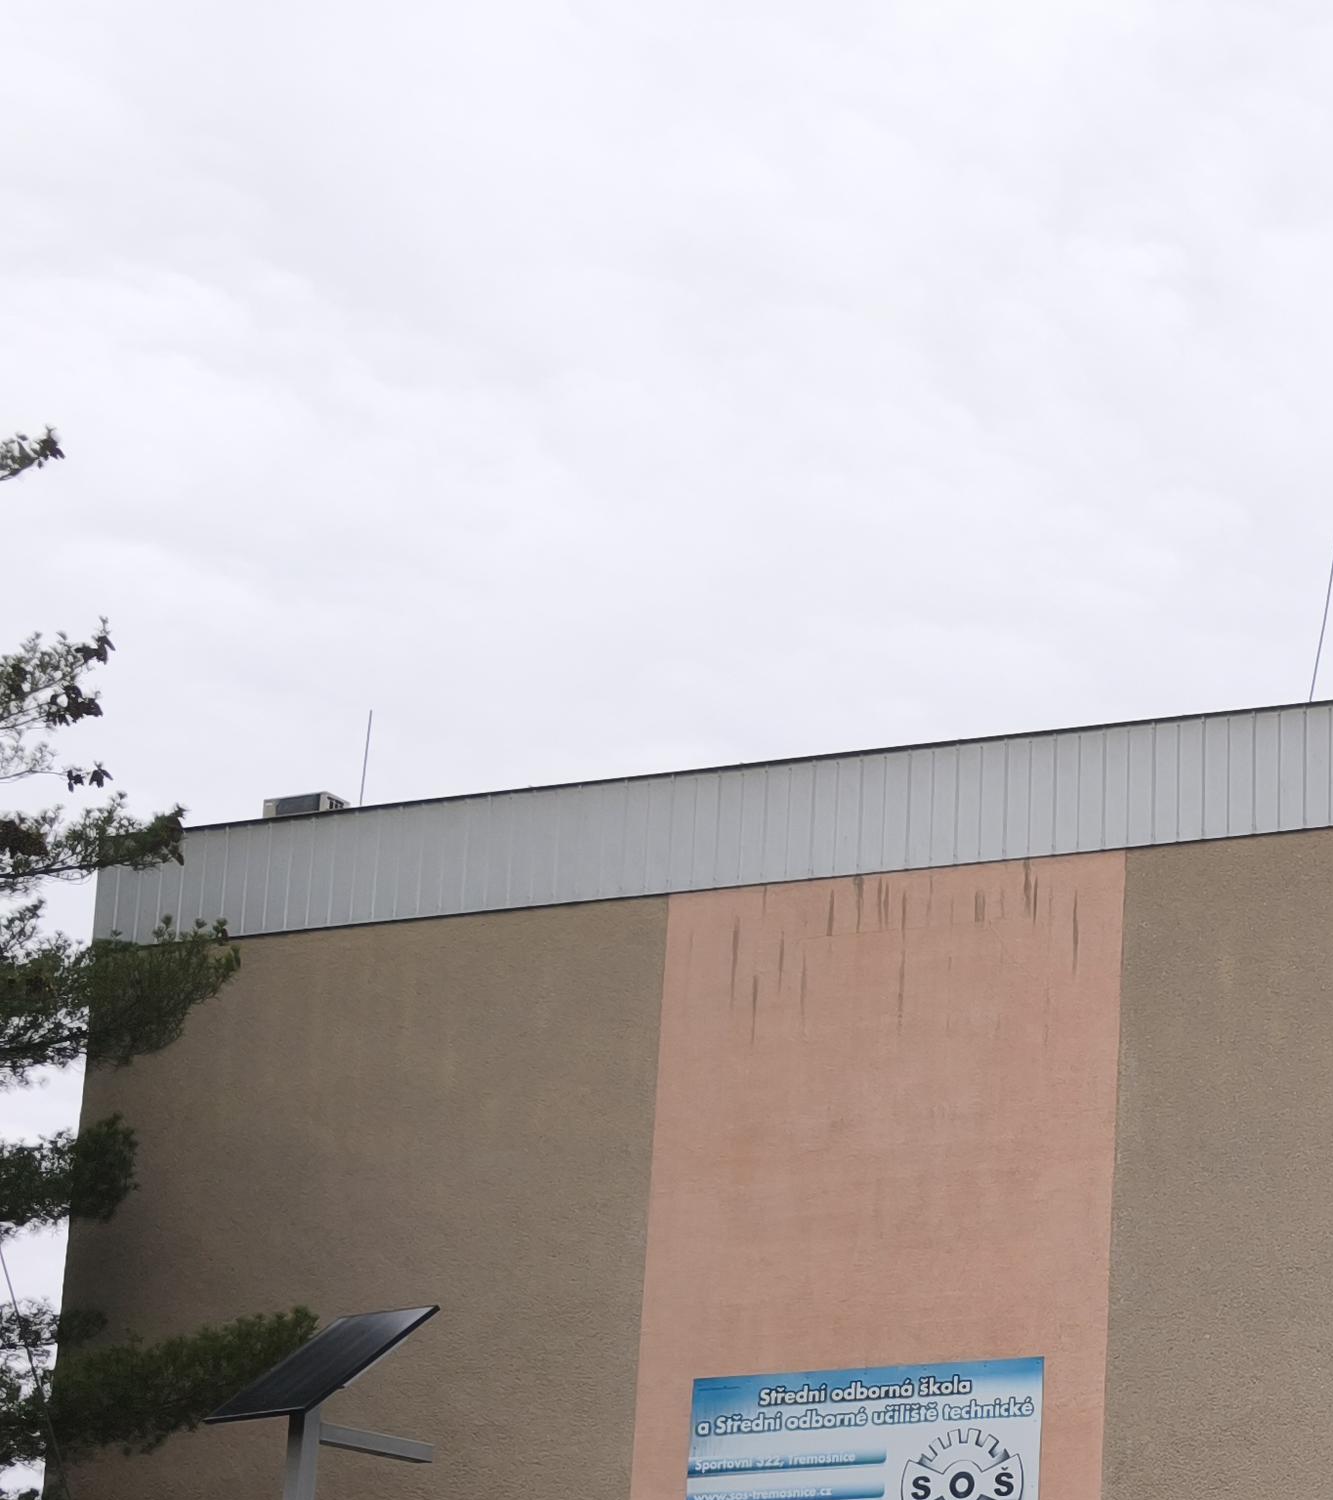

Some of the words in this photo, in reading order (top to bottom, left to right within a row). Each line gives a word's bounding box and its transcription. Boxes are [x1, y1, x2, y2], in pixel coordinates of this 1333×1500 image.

[759, 1383, 828, 1406] Střední
[830, 1378, 914, 1402] odborná
[919, 1375, 972, 1397] škola
[696, 1421, 710, 1436] a
[715, 1411, 782, 1436] Střední
[785, 1407, 868, 1431] odborné
[872, 1402, 938, 1426] učiliště
[943, 1397, 1034, 1421] technické
